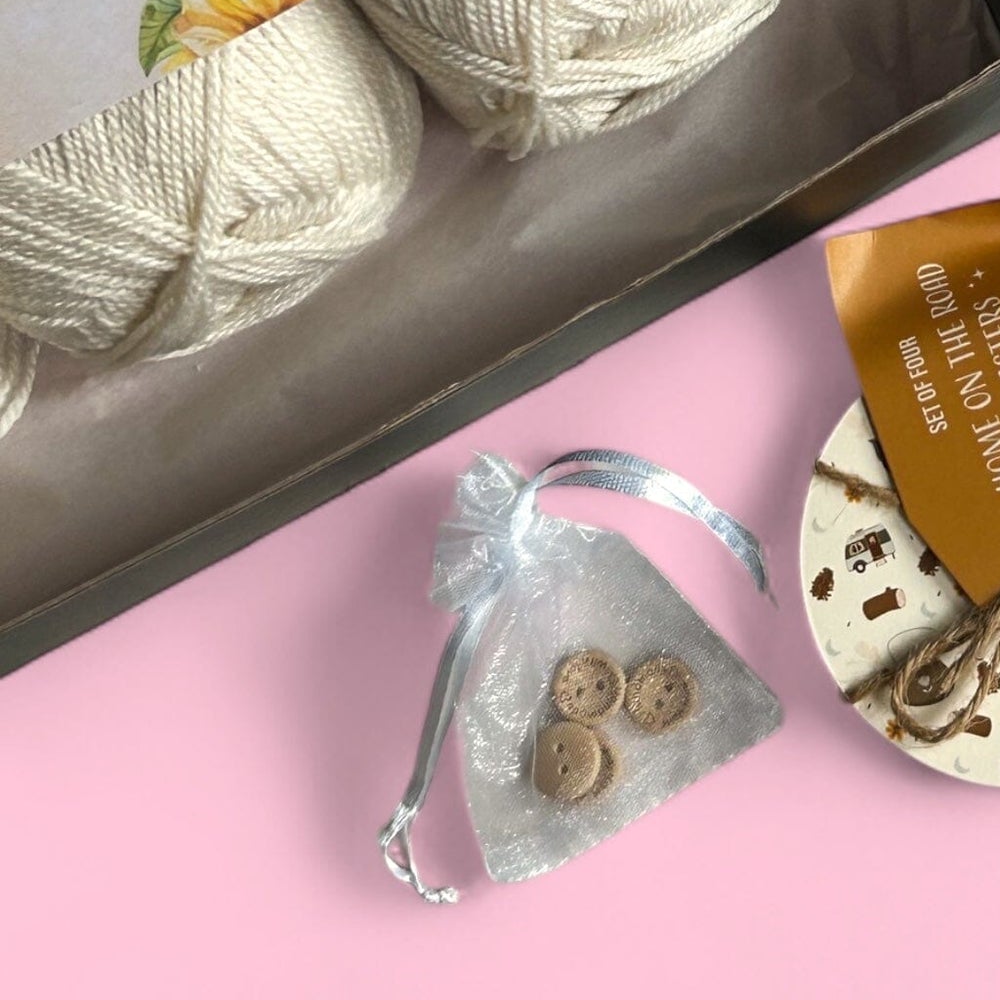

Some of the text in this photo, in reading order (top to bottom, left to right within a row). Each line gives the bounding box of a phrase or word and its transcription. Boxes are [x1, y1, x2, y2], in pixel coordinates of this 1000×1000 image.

[917, 263, 959, 319] ROAD
[937, 319, 975, 369] THE
[899, 336, 948, 434] SET OF FOUR
[954, 370, 992, 410] ON
